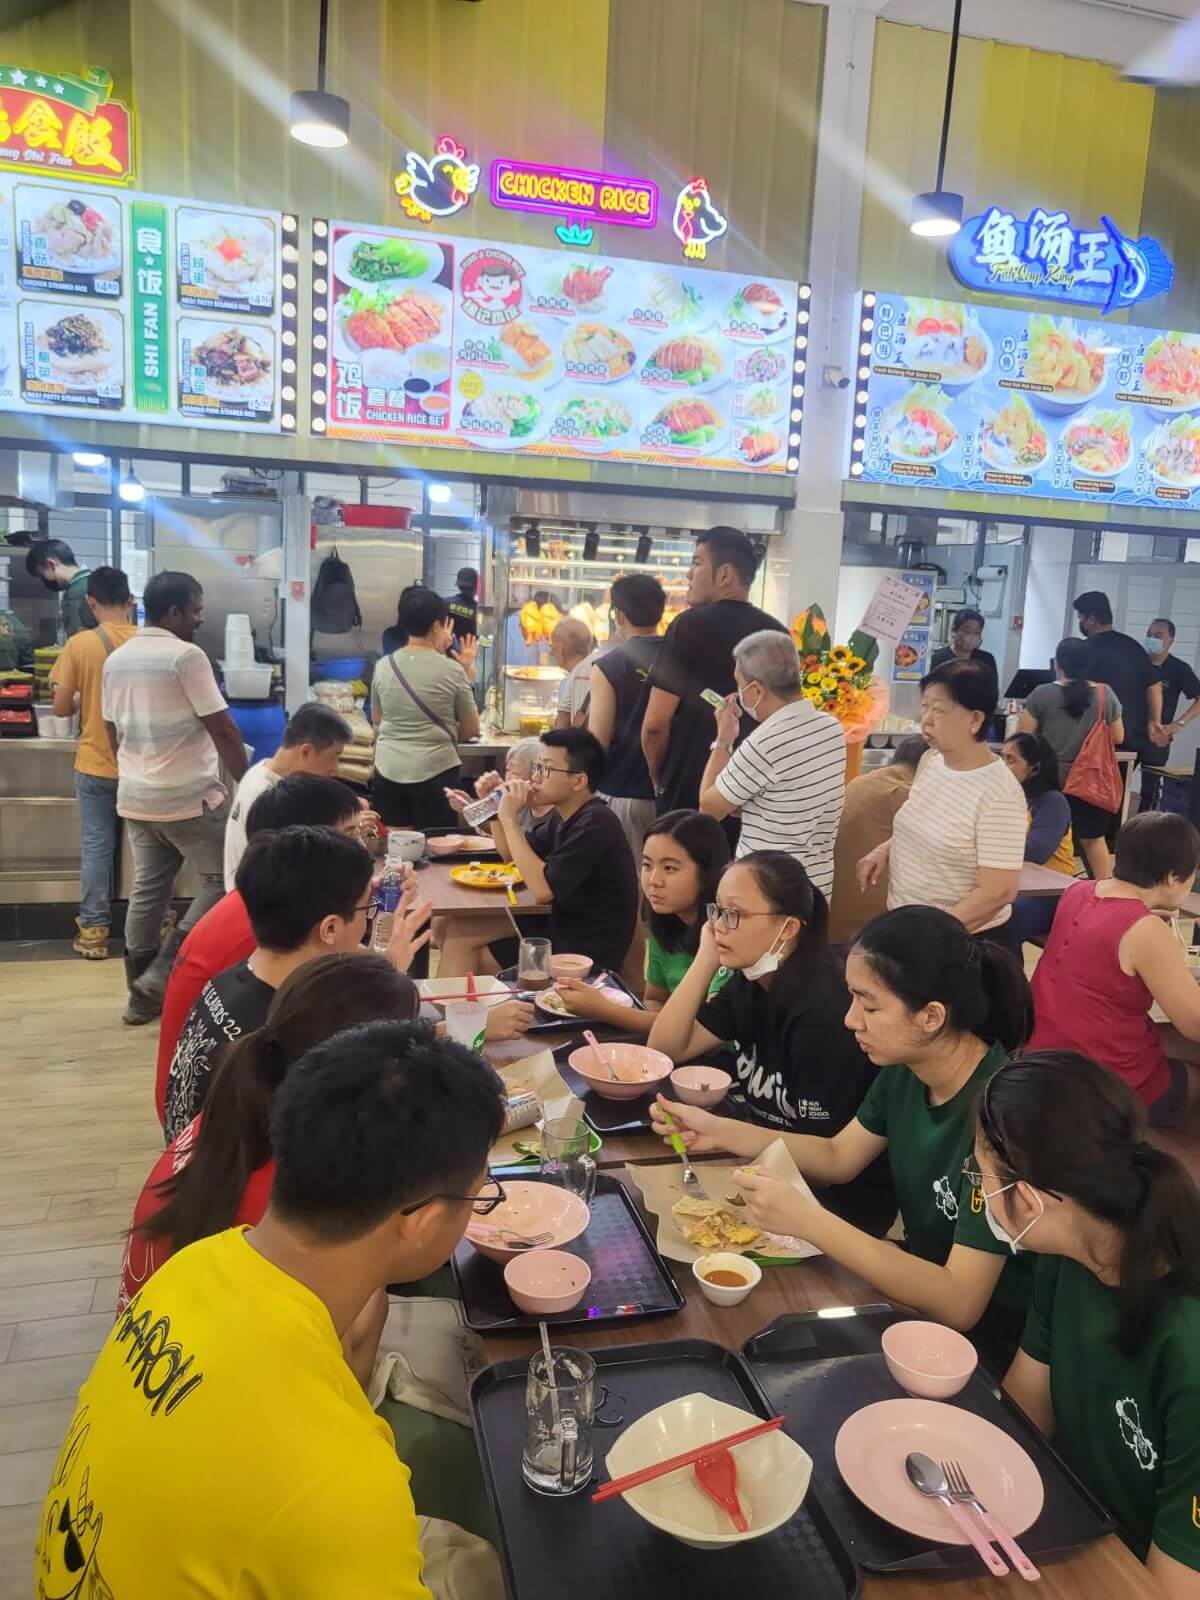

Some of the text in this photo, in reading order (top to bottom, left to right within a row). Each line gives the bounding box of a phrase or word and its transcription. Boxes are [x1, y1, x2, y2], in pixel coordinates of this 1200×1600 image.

[500, 171, 650, 215] CHICKEN RICE
[975, 207, 1112, 285] 鱼汤王
[143, 302, 160, 379] SHI FAN
[336, 361, 362, 419] 鸡饭
[367, 409, 445, 426] CHICKEN RICE SET
[222, 1018, 242, 1041] 22
